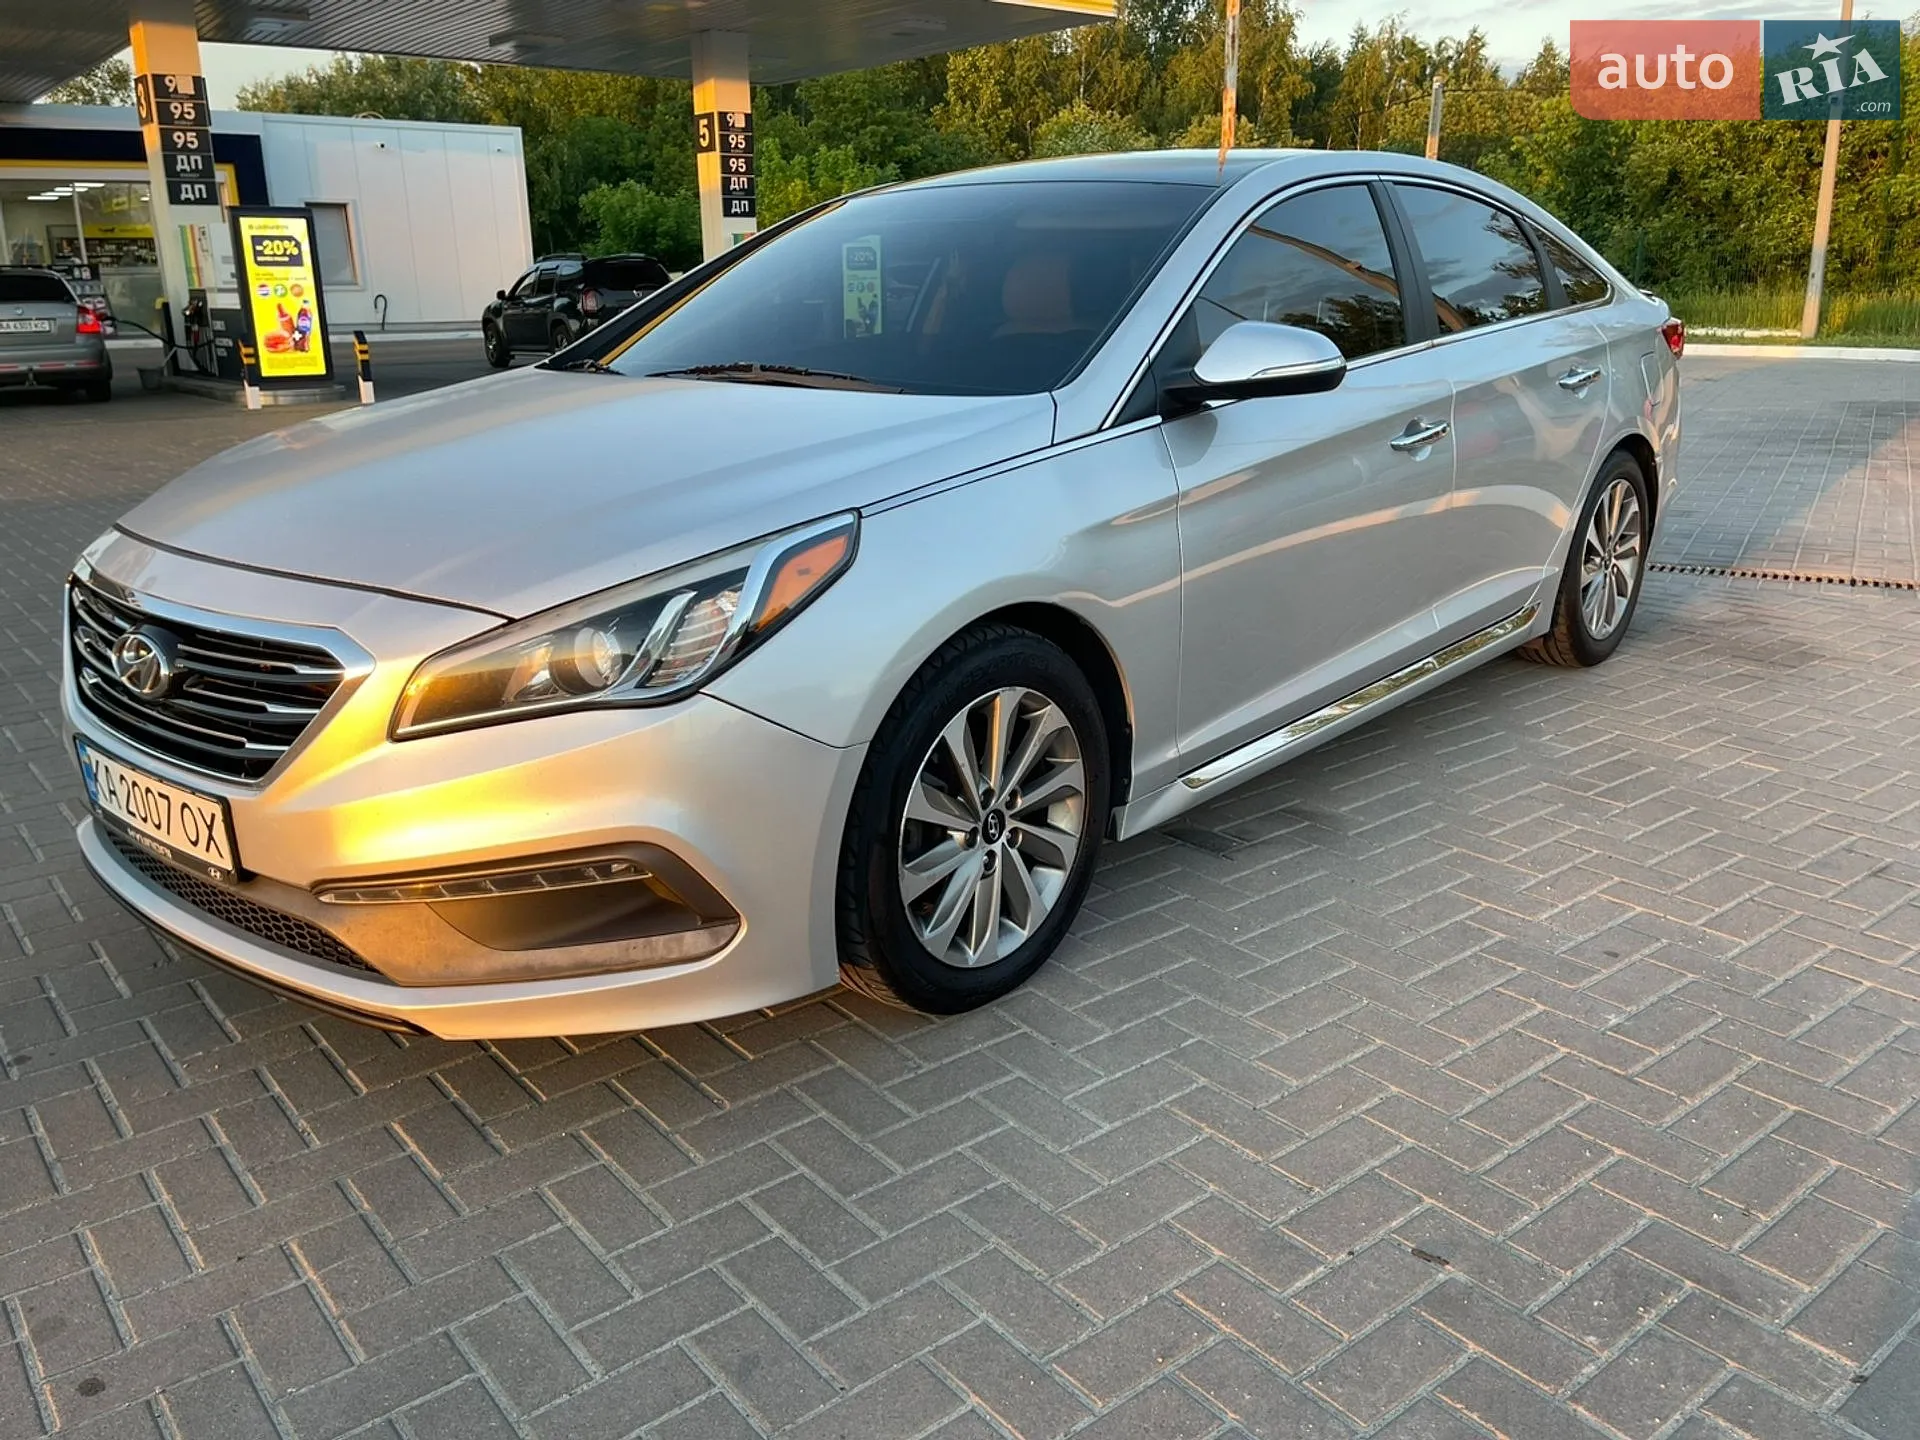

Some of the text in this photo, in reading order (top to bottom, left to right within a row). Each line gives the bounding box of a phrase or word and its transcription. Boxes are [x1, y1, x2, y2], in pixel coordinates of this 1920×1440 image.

[137, 82, 147, 119] 3
[170, 102, 196, 120] 95
[172, 131, 199, 149] 95
[699, 118, 709, 148] 5
[728, 134, 746, 149] 95
[176, 154, 203, 172] ДП
[729, 158, 747, 172] 95
[180, 183, 207, 201] ДП
[729, 177, 748, 191] ДП
[731, 200, 749, 214] ДП
[255, 240, 299, 255] -20%
[91, 760, 122, 812] KA
[119, 773, 172, 836] 2007
[180, 801, 224, 859] OX
